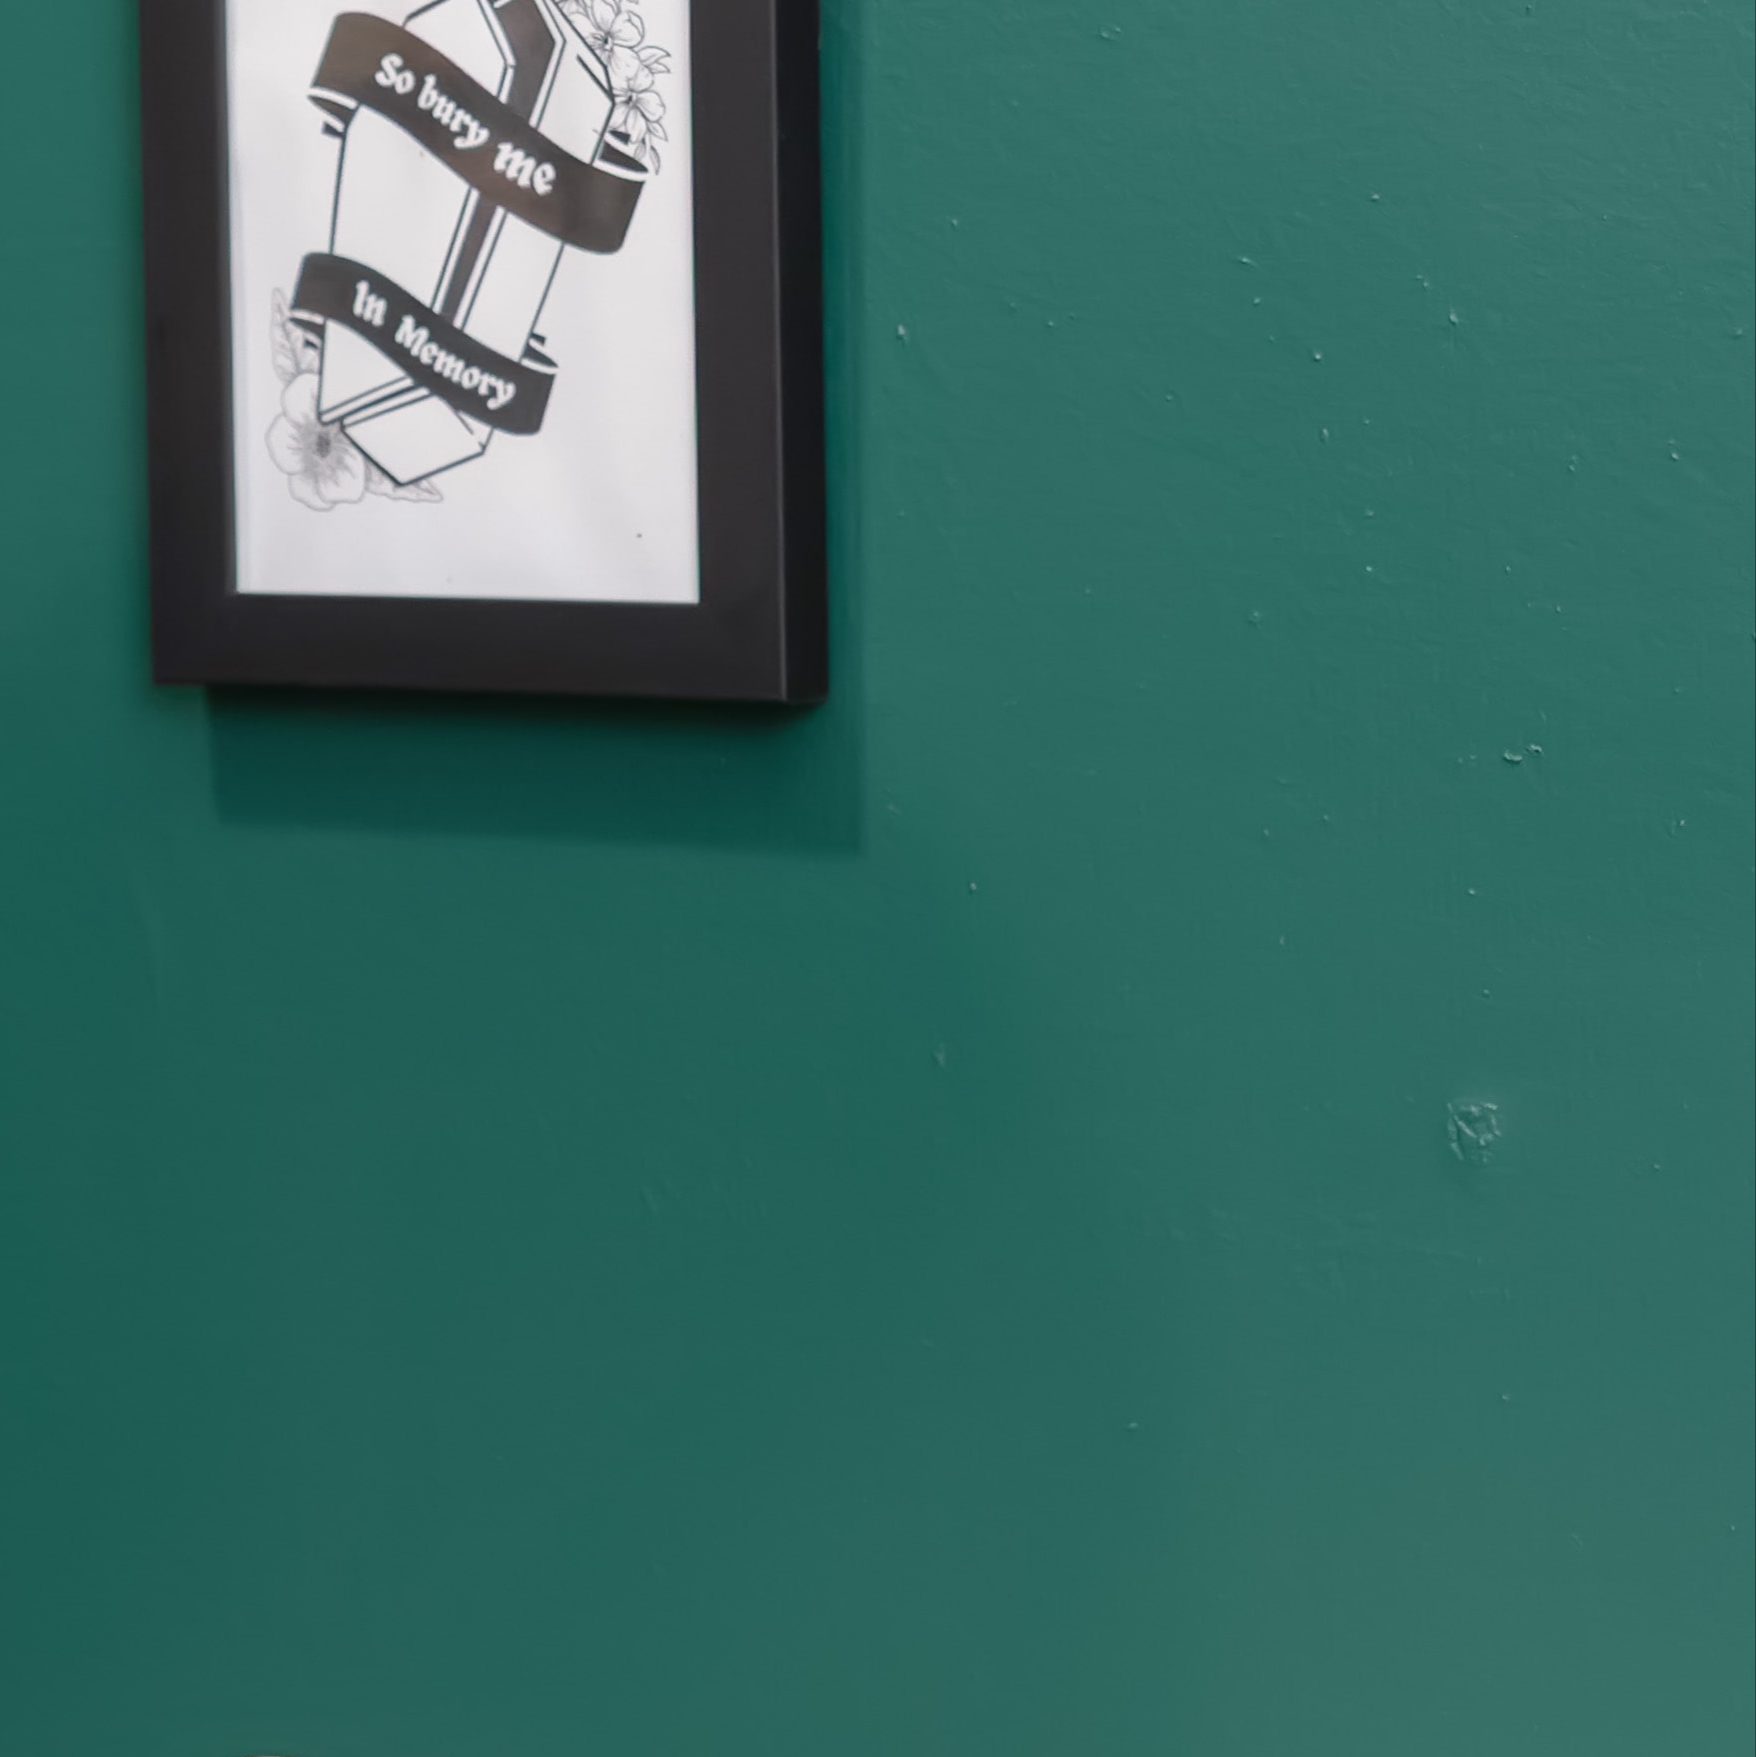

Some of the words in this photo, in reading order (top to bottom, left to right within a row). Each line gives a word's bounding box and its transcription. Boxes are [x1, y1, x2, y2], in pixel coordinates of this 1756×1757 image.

[374, 53, 415, 95] So
[417, 74, 491, 150] bury
[493, 141, 557, 196] me
[353, 279, 388, 327] In
[394, 314, 516, 411] Memory
